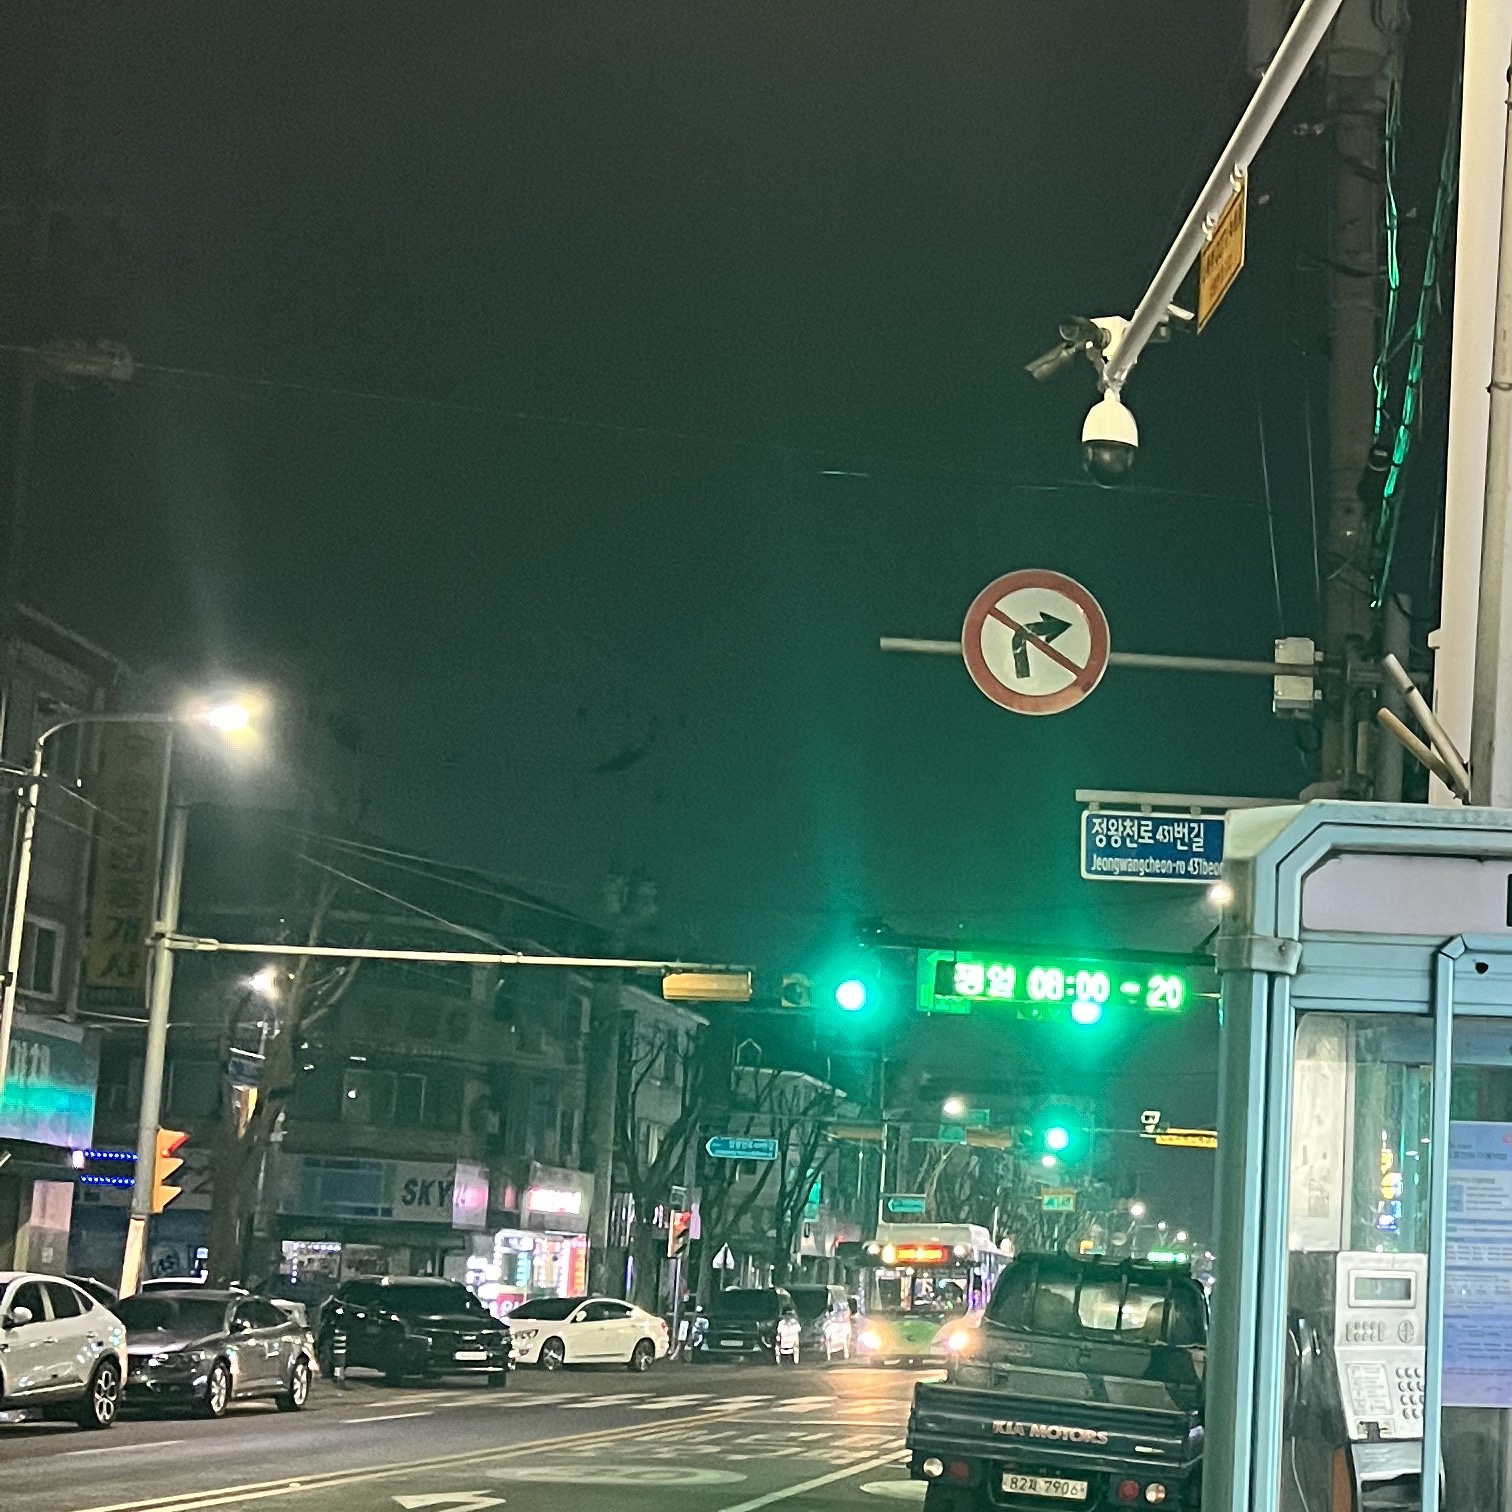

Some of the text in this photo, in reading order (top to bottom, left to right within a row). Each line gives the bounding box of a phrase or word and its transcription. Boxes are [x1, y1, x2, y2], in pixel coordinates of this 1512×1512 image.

[1091, 853, 1186, 877] Jeongwangcheon-ro
[1146, 975, 1185, 1010] 20
[992, 1420, 1109, 1445] KIA MOTORS
[1044, 1480, 1079, 1496] 7906
